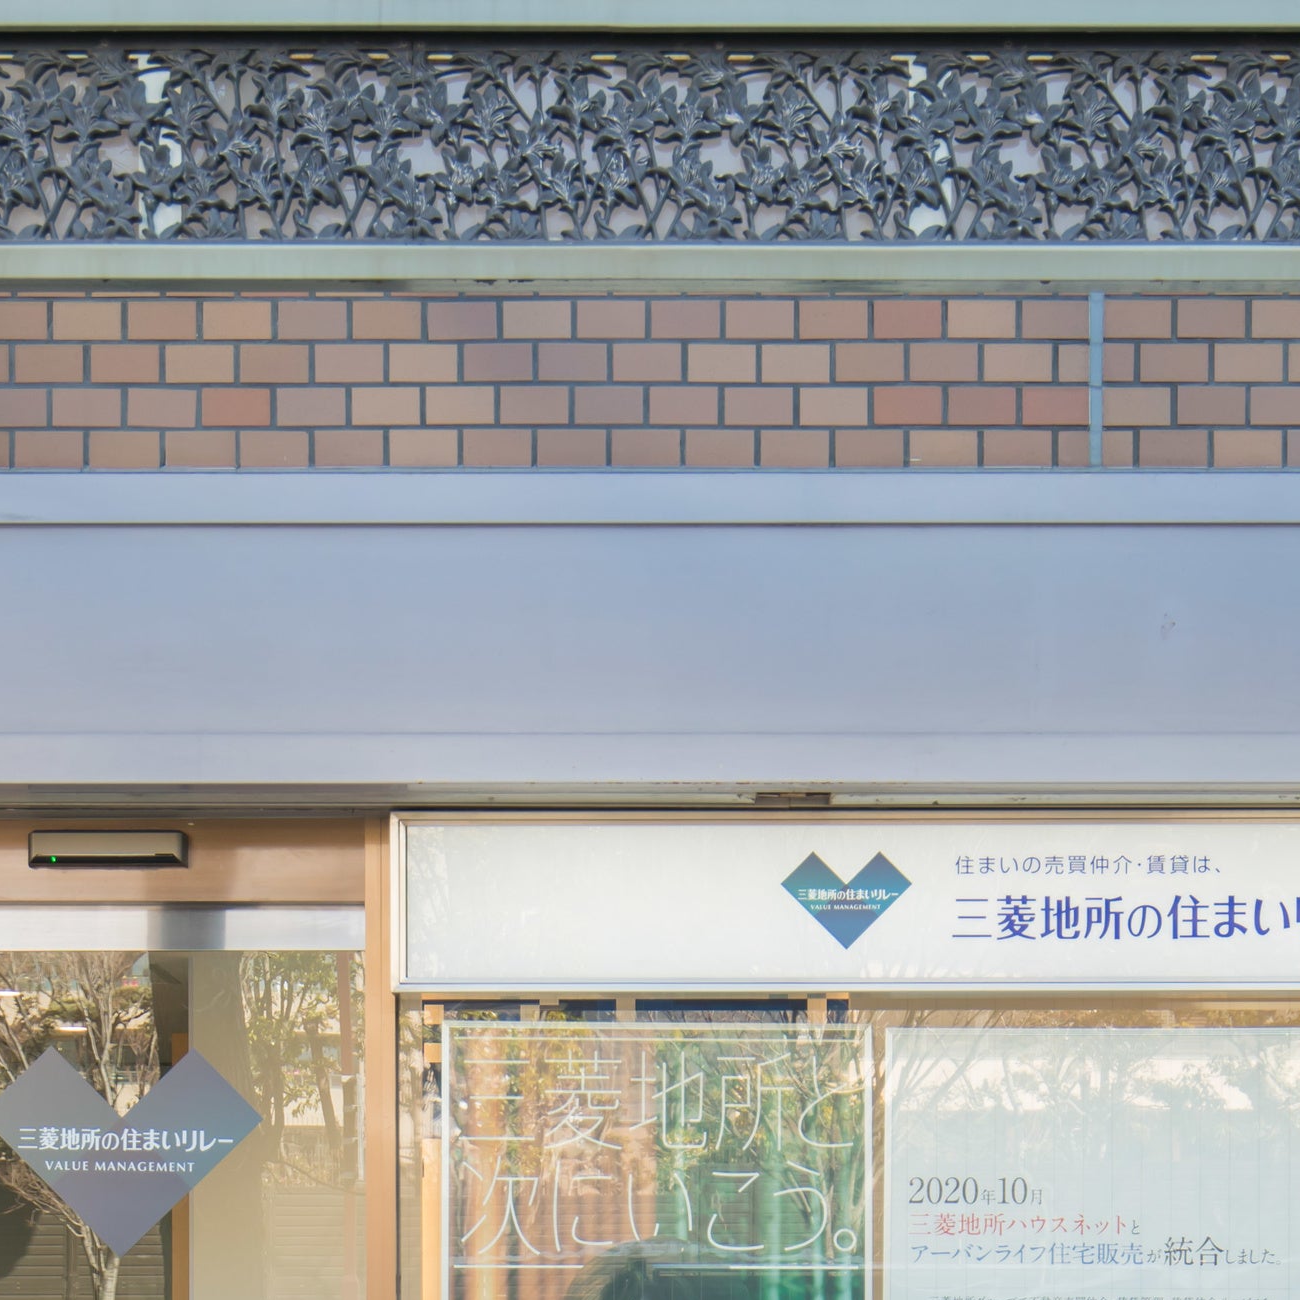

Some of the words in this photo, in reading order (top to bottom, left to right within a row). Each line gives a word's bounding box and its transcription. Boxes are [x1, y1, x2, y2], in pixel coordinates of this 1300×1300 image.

[954, 855, 1222, 875] 住まいの売買仲介・賃貸は、
[797, 889, 899, 900] 三菱地所の住まいリレー
[460, 1051, 855, 1151] 三菱地所と
[19, 1127, 234, 1152] 三菱地所の住まいリレー
[45, 1160, 90, 1173] VALUE
[94, 1160, 195, 1173] MANAGEMENT
[908, 1176, 1044, 1205] 2020年10月
[460, 1160, 859, 1256] 次にいこう。
[908, 1213, 1140, 1236] 三菱地所ハウスネットと
